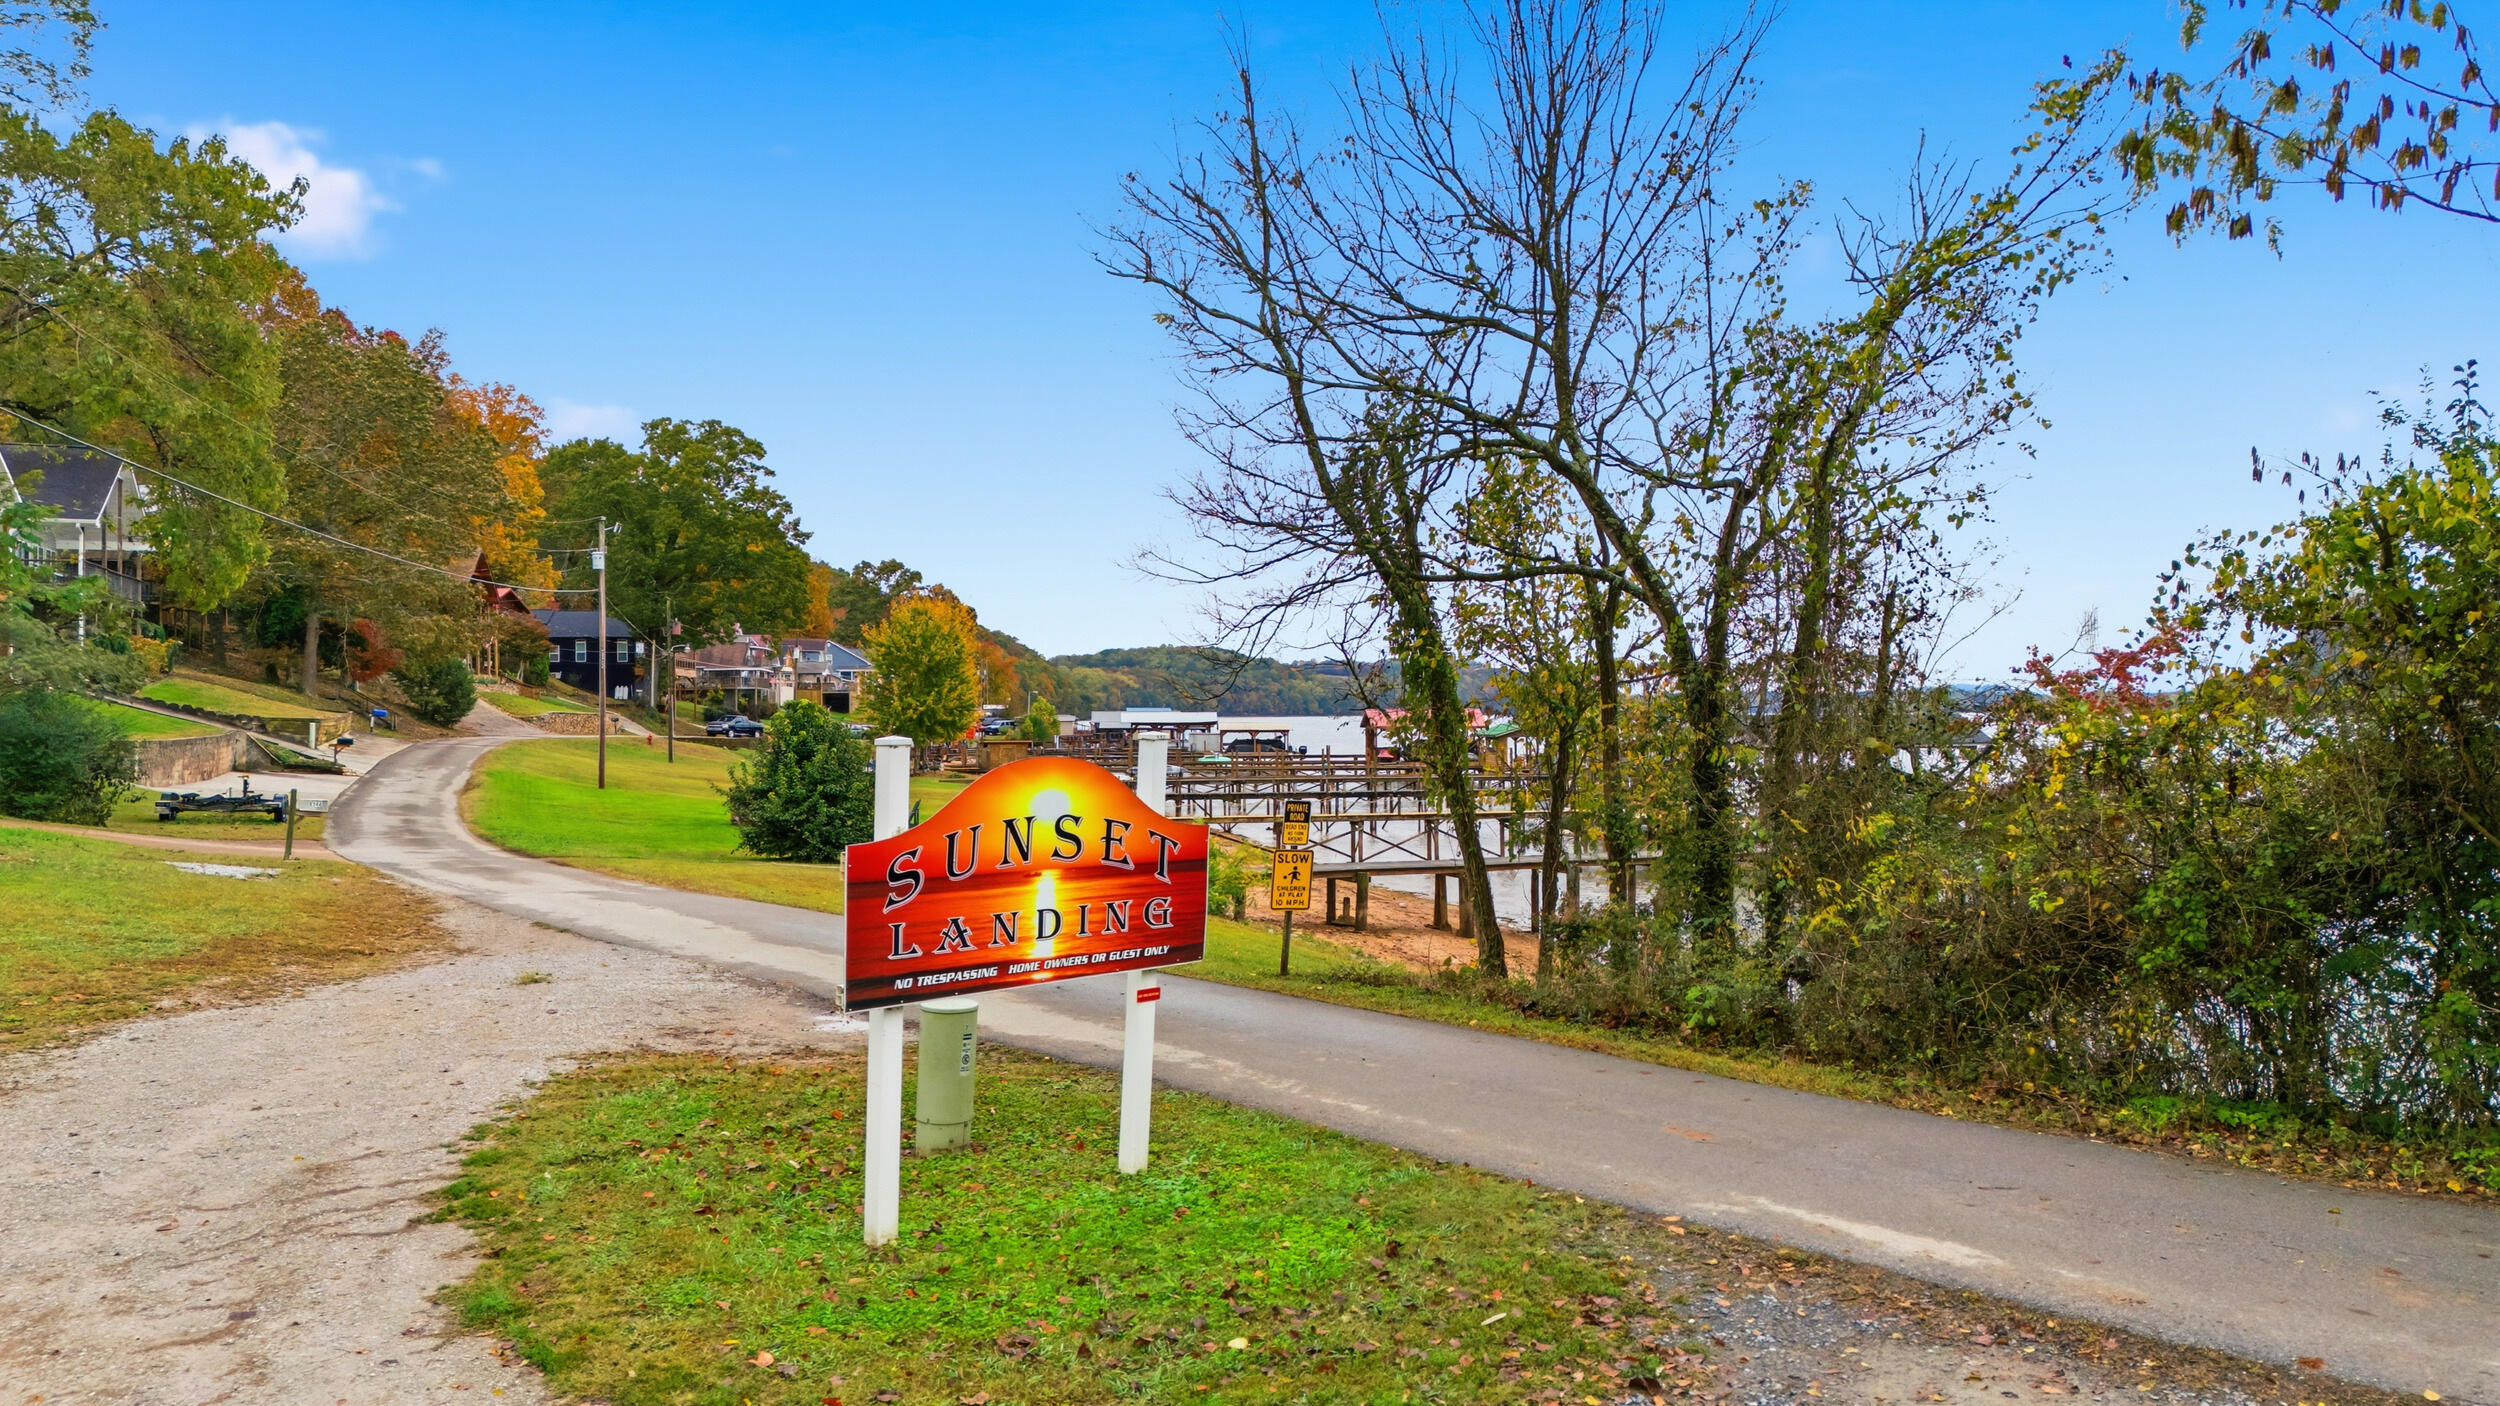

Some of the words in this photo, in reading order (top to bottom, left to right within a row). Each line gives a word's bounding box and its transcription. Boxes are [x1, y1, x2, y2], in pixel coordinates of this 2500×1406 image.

[1287, 803, 1309, 813] PRIVATE
[1290, 813, 1304, 821] ROAD
[882, 814, 1181, 914] SUNSET
[1278, 854, 1309, 863] SLOW
[888, 897, 1174, 960] LANDING
[894, 977, 914, 990] NO
[917, 966, 998, 987] TRESPASSING
[1008, 960, 1041, 975] HOME
[1044, 954, 1089, 970] OWNERS
[1091, 951, 1106, 964] OR
[1109, 948, 1142, 961] GUEST
[1144, 945, 1171, 957] ONLY
